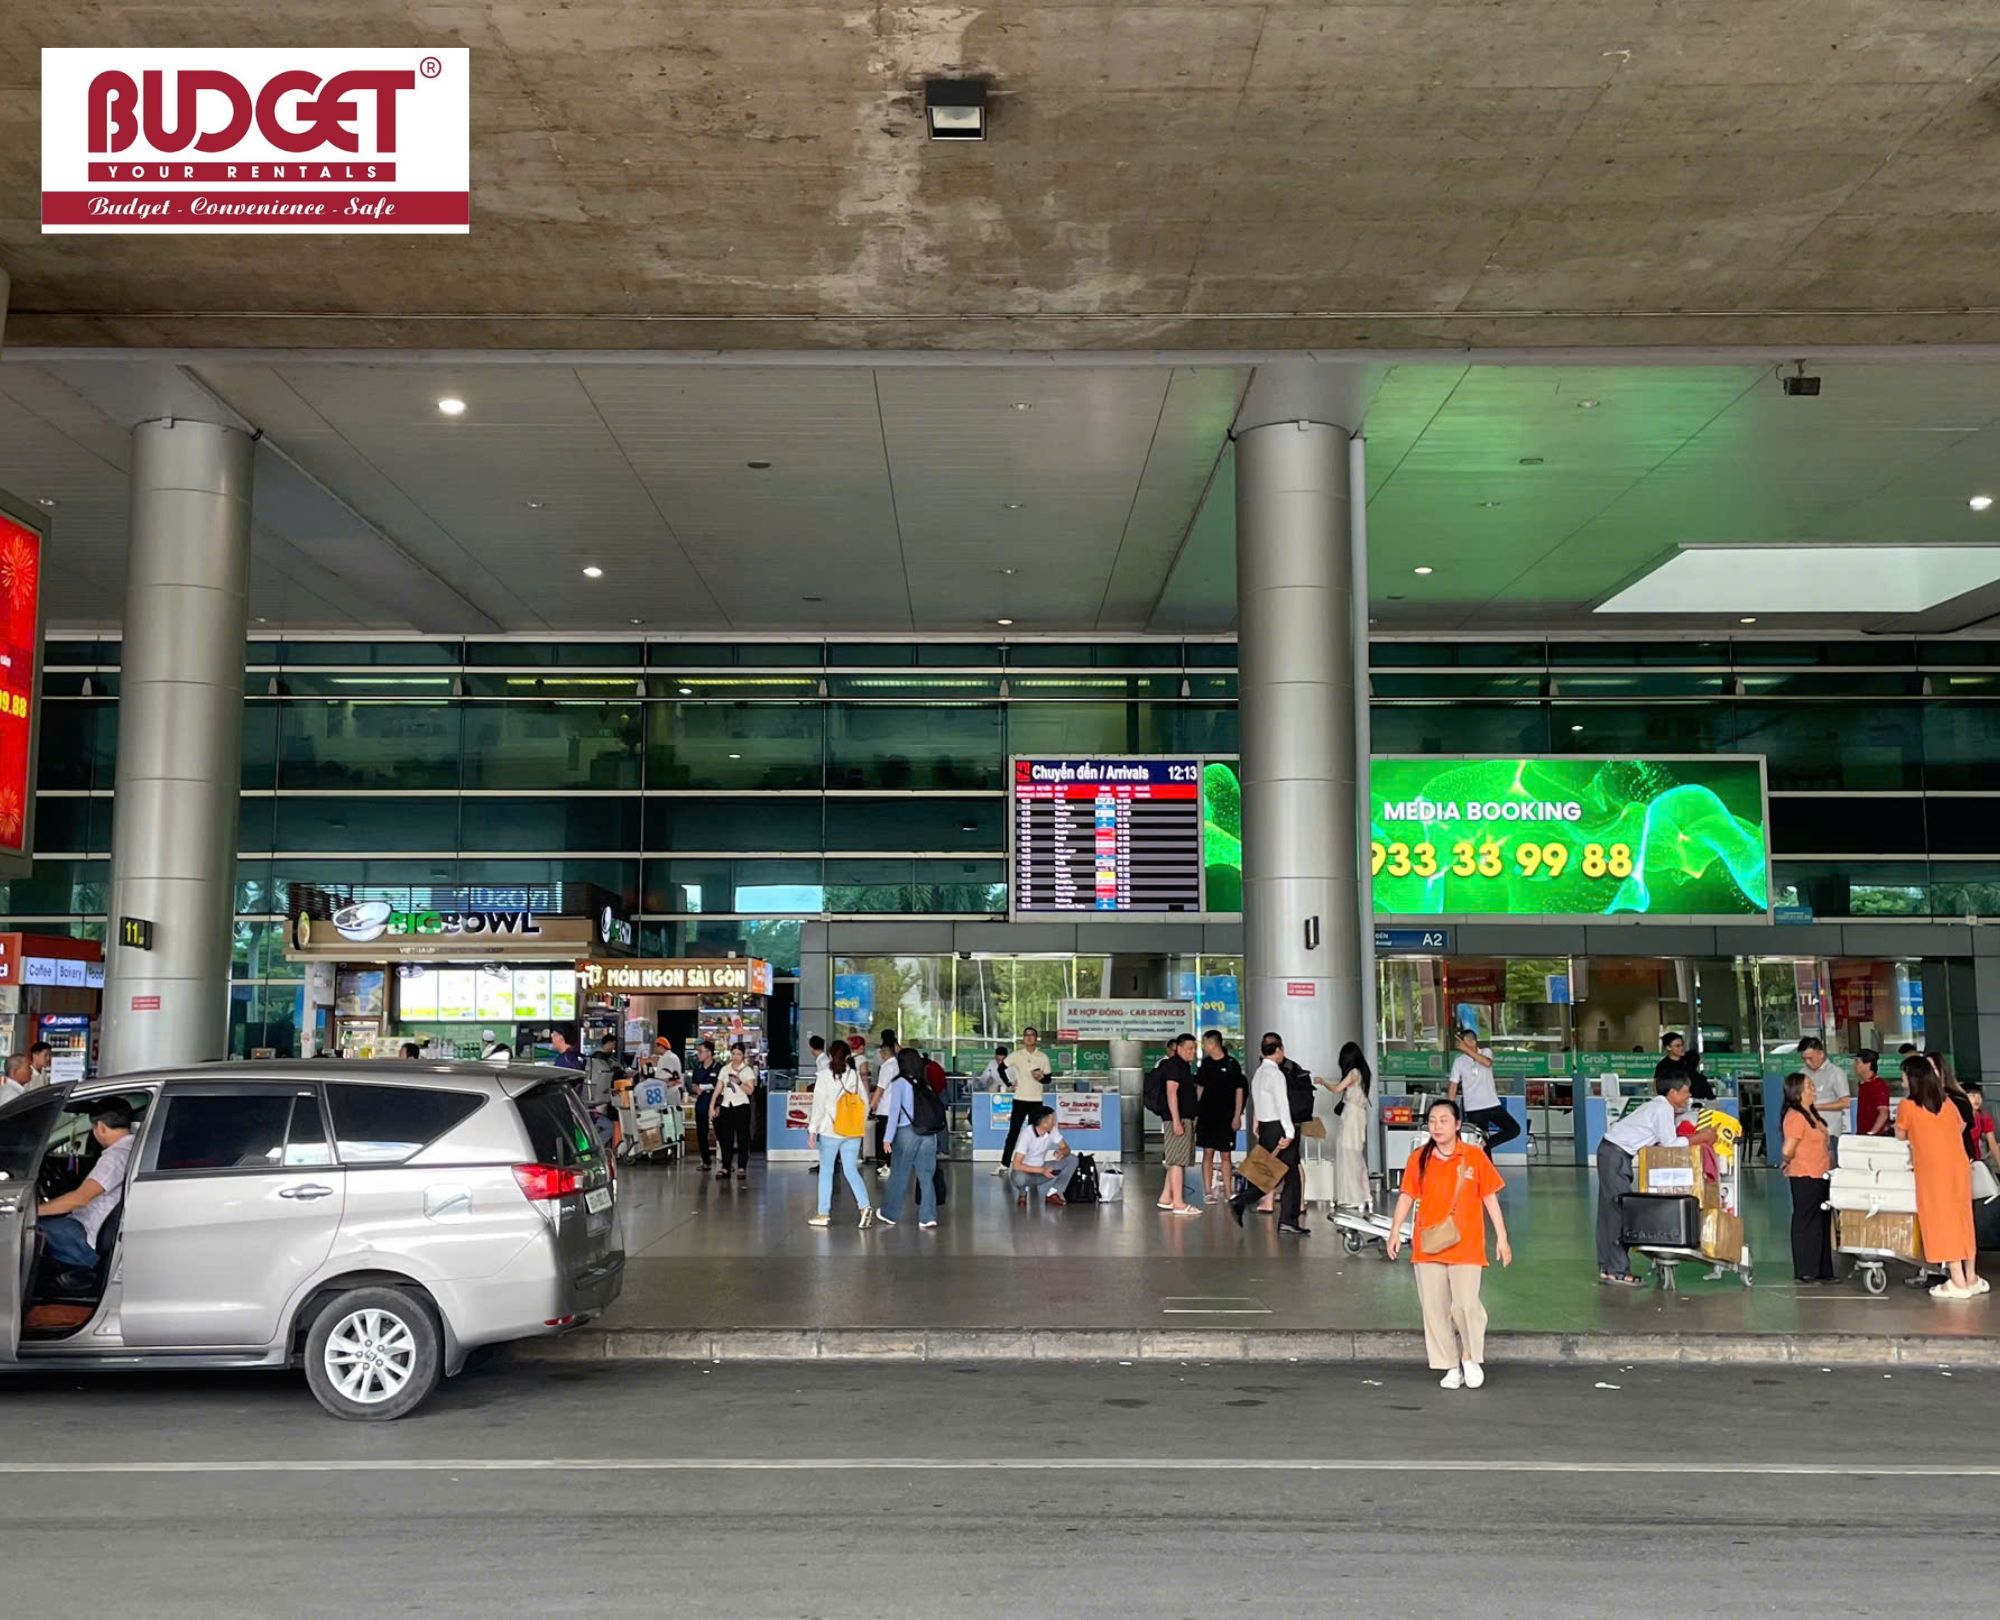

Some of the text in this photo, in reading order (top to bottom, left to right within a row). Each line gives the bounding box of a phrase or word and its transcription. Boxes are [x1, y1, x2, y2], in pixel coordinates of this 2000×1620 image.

[1031, 762, 1075, 783] Chuyến
[1077, 762, 1098, 780] đến
[1106, 764, 1150, 780] Arrivals
[1167, 765, 1198, 780] 12:13
[1384, 801, 1582, 821] MEDIA BOOKING
[1452, 842, 1503, 877] 33
[1516, 842, 1568, 877] 99
[1582, 843, 1633, 878] 88
[1422, 933, 1443, 946] A2
[29, 964, 52, 977] Coffee
[60, 966, 82, 980] Bakery
[607, 965, 640, 987] MÓN
[642, 969, 685, 987] NGON
[687, 965, 710, 987] SÀI
[713, 965, 746, 987] GÒN
[1067, 1008, 1078, 1016] XE
[1079, 1007, 1097, 1017] HỢP
[1130, 1009, 1146, 1017] CAR
[1148, 1009, 1186, 1017] SERVICES
[57, 1016, 82, 1025] pepsi
[1083, 1051, 1109, 1061] Grab
[1582, 1054, 1608, 1064] Grab
[646, 1088, 662, 1105] 88
